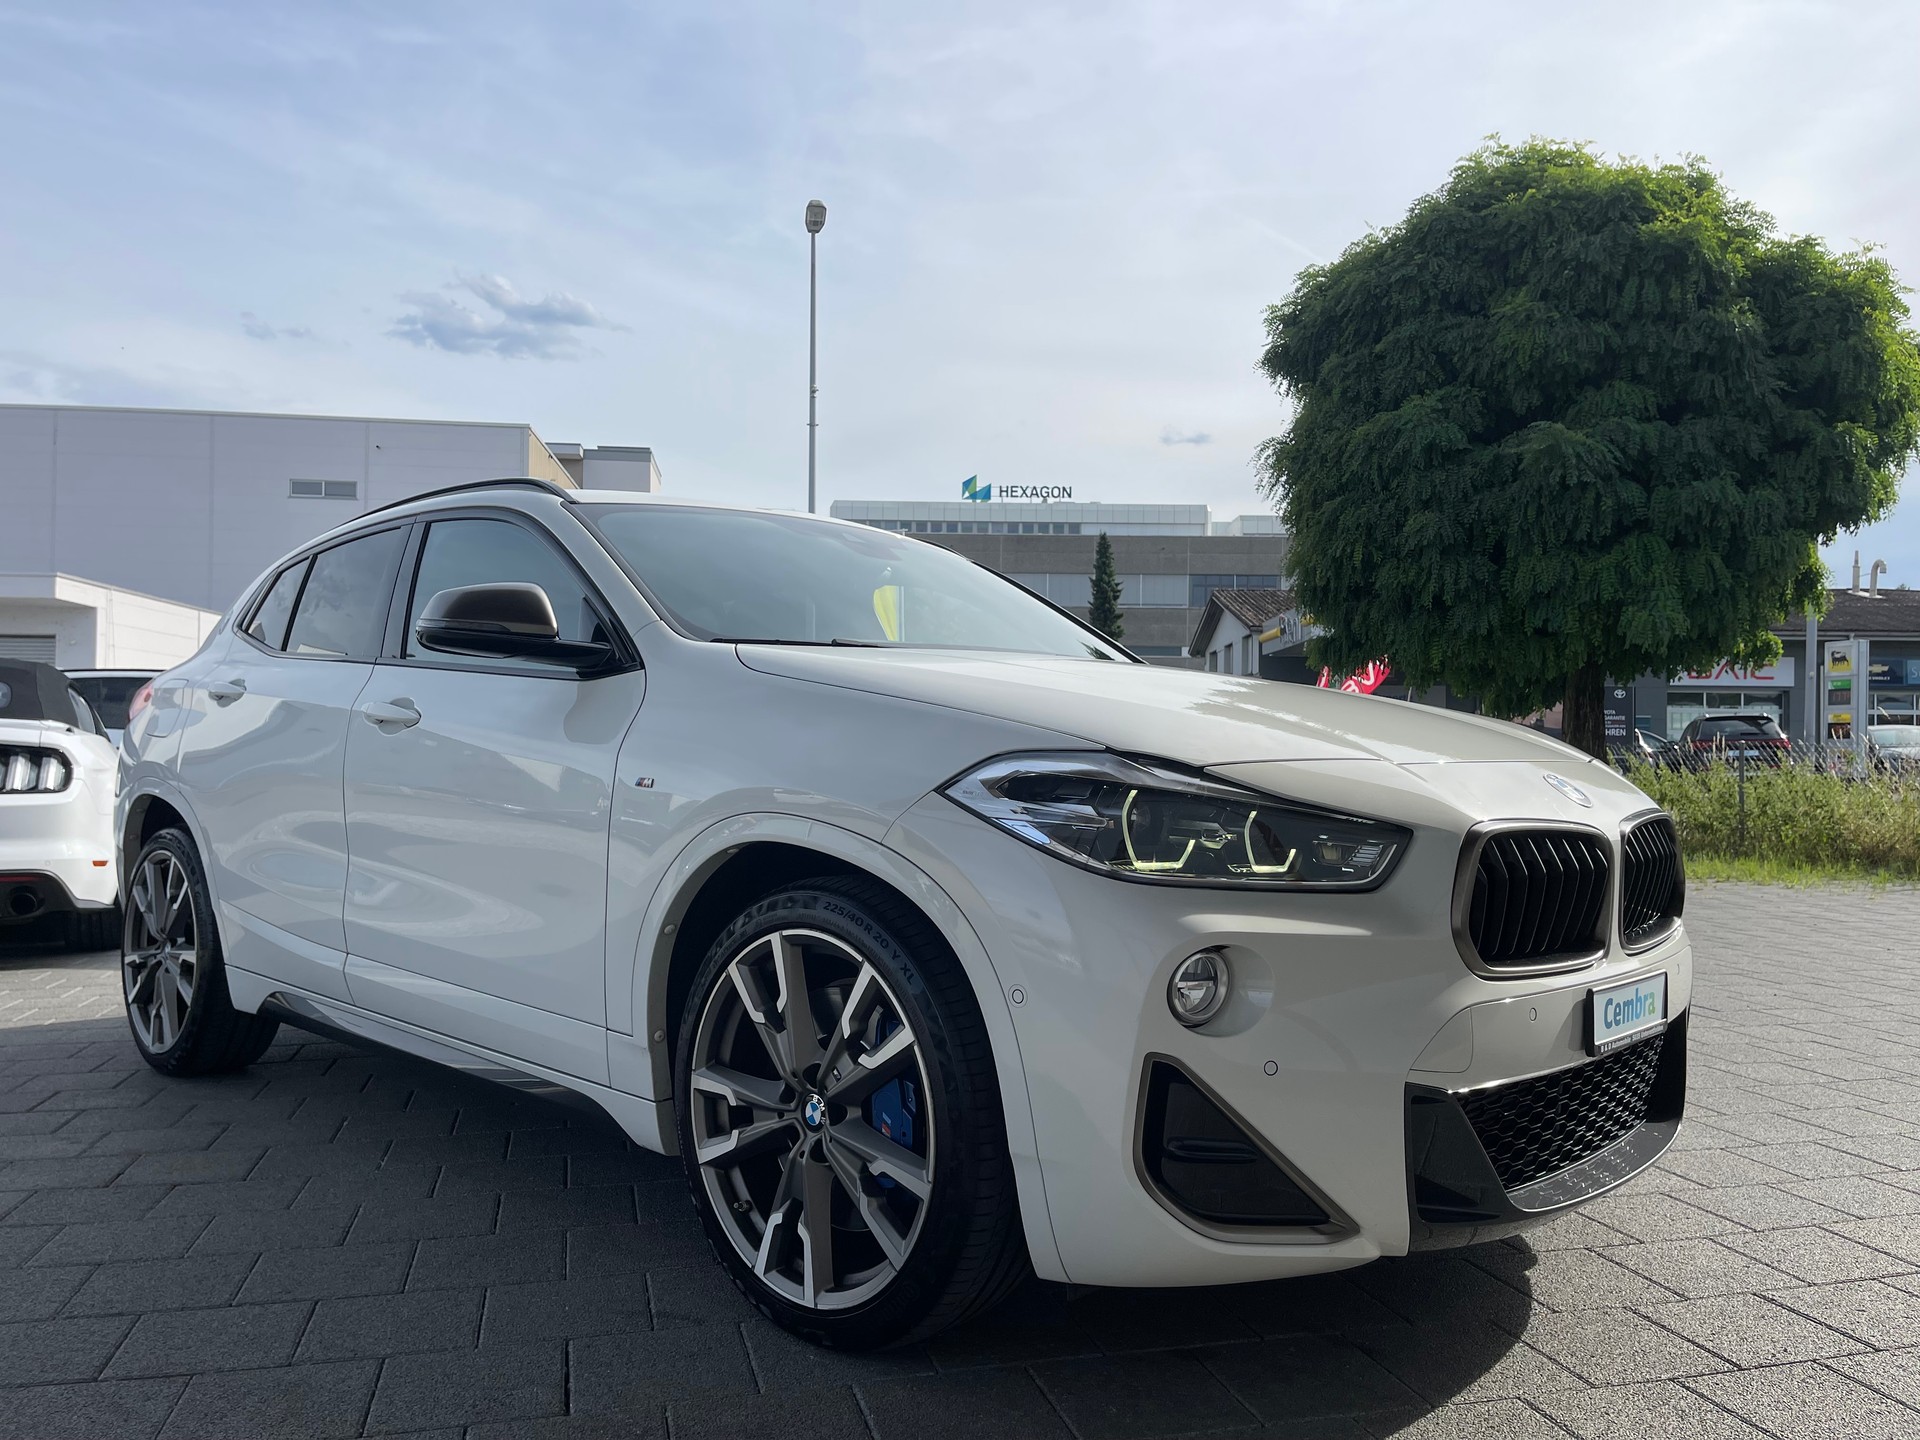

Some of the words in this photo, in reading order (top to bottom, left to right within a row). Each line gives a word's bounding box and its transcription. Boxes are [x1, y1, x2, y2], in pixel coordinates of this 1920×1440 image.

[999, 485, 1072, 498] HEXAGON
[823, 901, 864, 928] 225/40
[864, 922, 874, 935] R
[872, 932, 890, 949] 20
[891, 949, 903, 960] Y
[900, 962, 916, 985] XL
[1603, 987, 1656, 1029] Cembra
